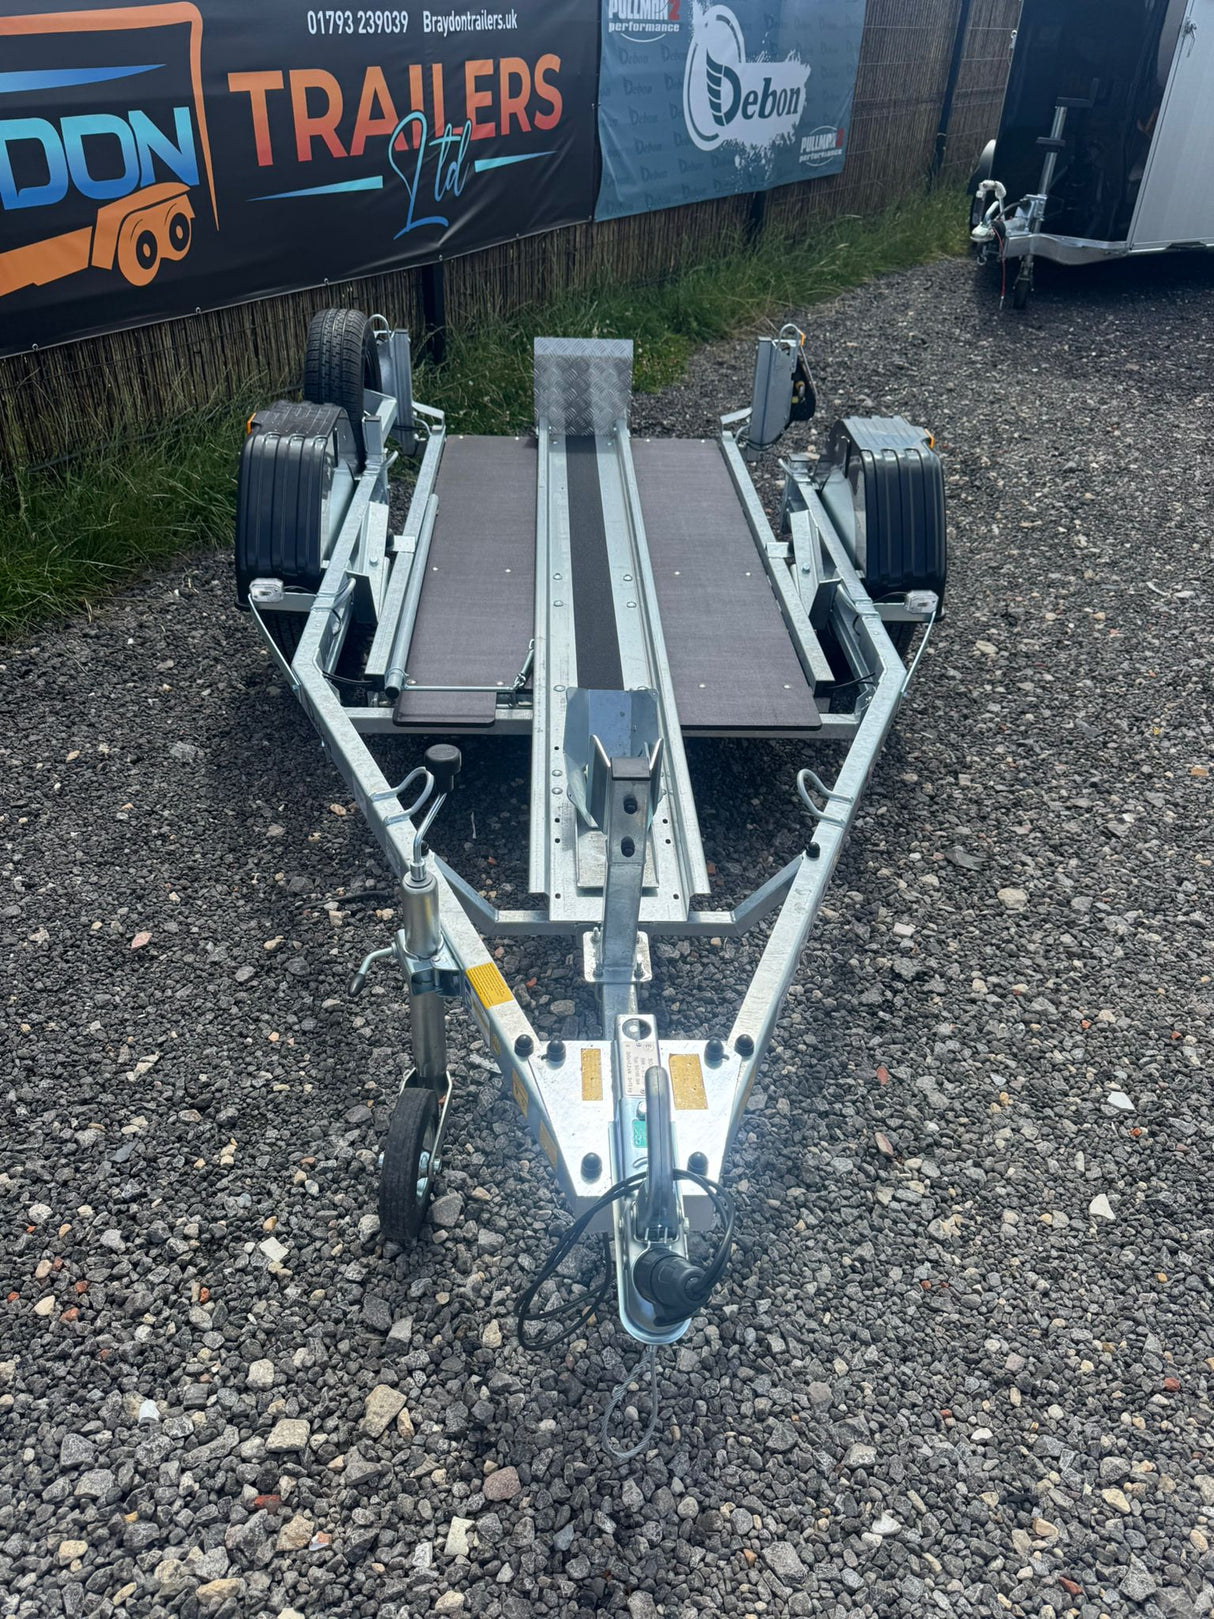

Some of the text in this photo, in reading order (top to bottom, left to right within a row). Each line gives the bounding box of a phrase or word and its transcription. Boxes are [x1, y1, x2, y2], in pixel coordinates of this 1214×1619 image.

[307, 9, 518, 37] 01793 239039 Braydontrailers.uk
[608, 21, 680, 32] performance
[227, 53, 563, 167] TRAILERS
[706, 48, 801, 126] Debon
[388, 111, 472, 240] Ltd
